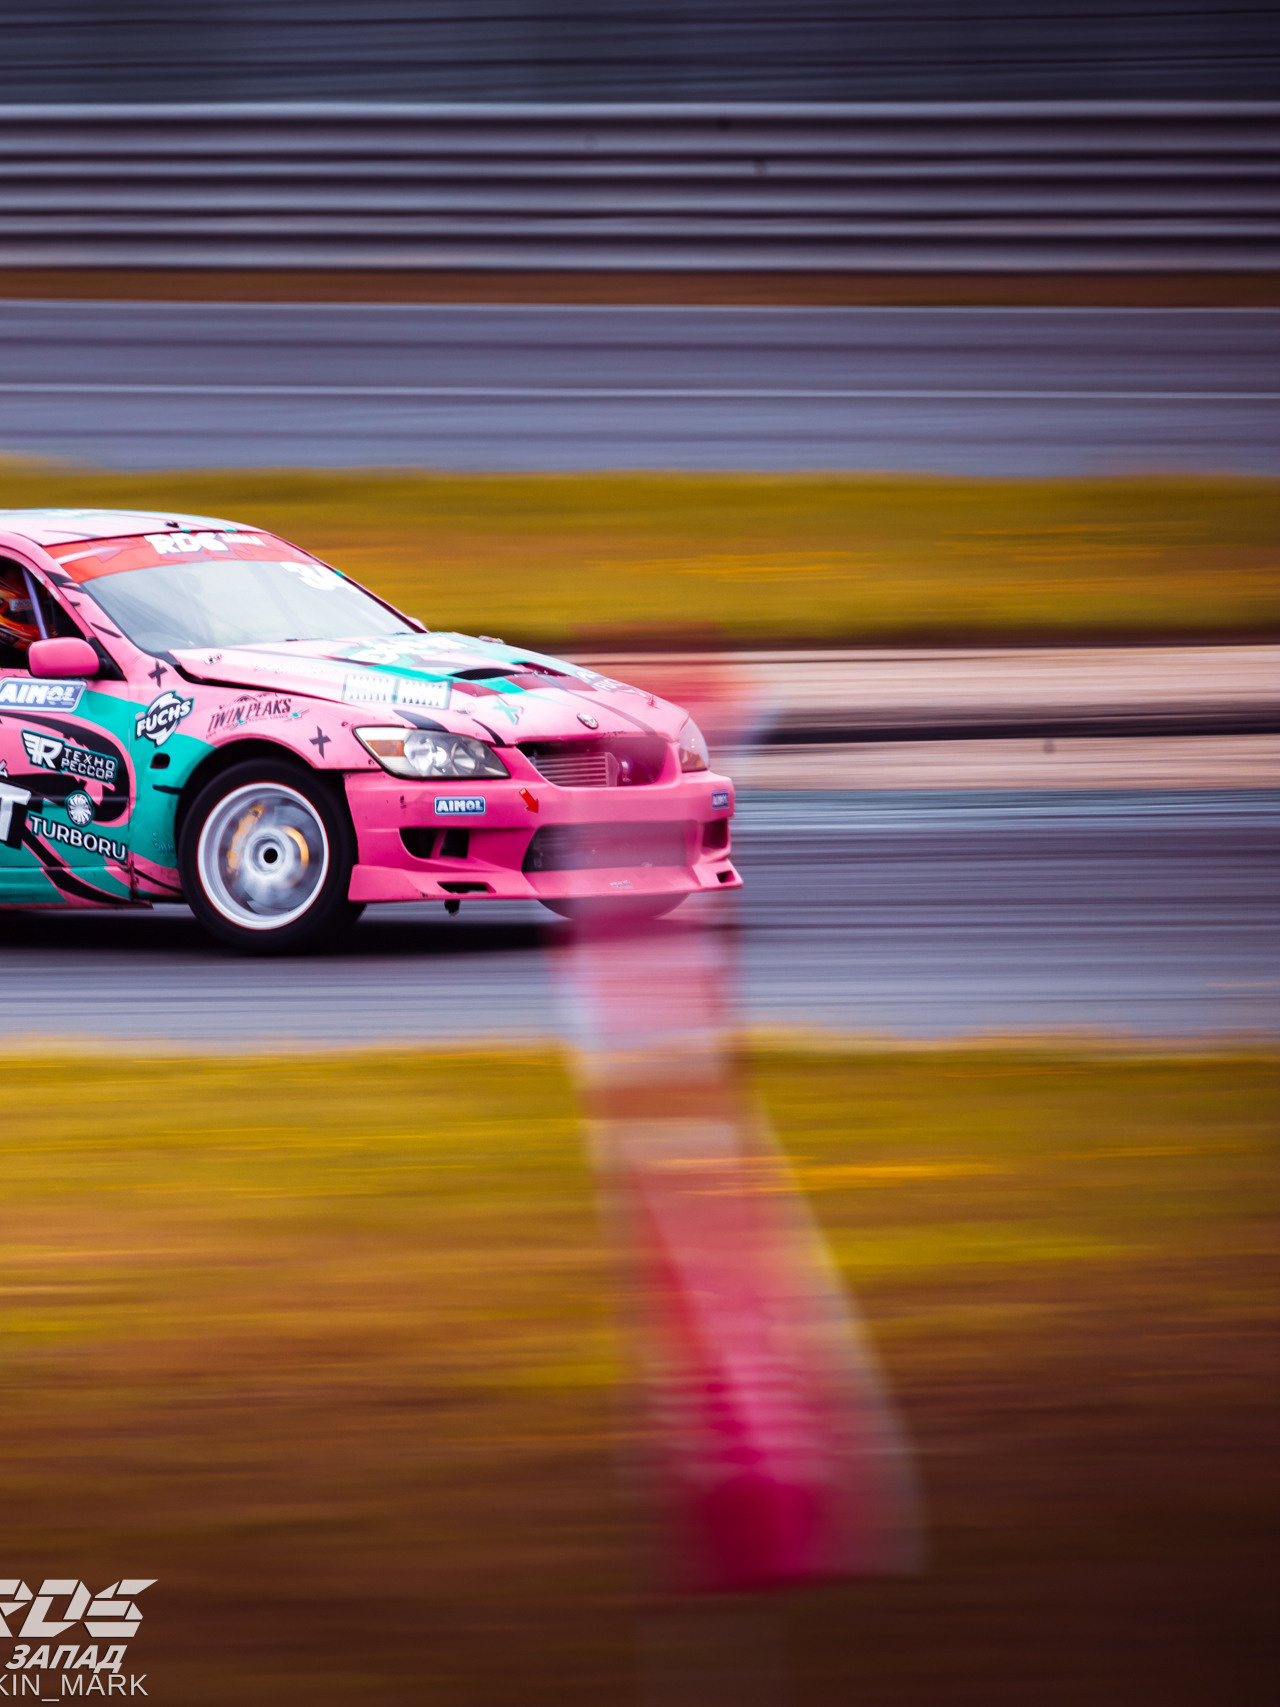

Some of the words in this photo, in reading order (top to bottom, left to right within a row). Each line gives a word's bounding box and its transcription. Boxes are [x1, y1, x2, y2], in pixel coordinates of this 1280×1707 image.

[144, 532, 230, 555] RDS
[136, 700, 192, 738] FUCHS
[207, 705, 245, 734] TWIN
[246, 698, 292, 721] PEAKS
[436, 800, 484, 812] AIMOL
[30, 815, 126, 861] TURBORU
